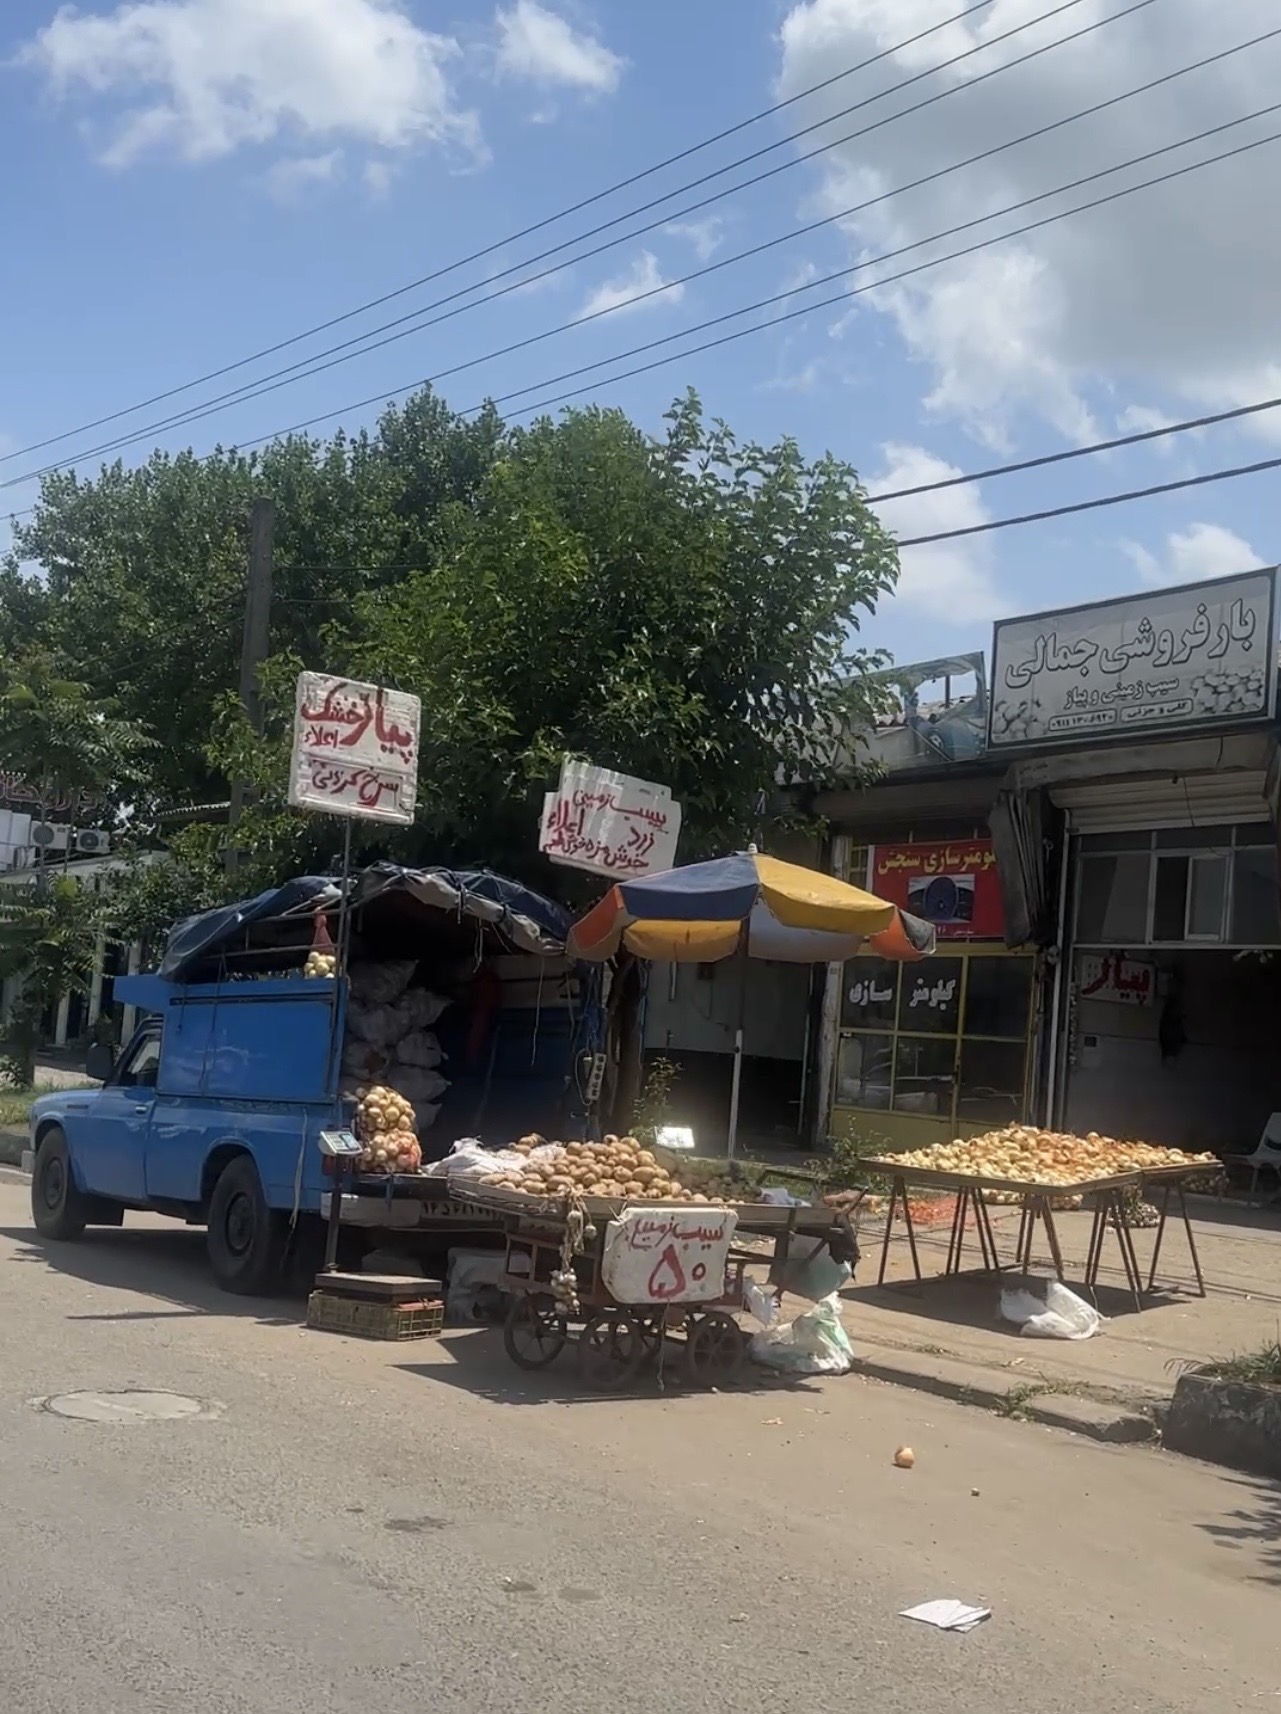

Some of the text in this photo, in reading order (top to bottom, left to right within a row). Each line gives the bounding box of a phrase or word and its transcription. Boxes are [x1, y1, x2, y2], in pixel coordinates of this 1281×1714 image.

[1004, 632, 1099, 689] جمالی
[1063, 677, 1180, 711] سیب زمینی و پیاز
[300, 682, 414, 764] پیاز خشک
[311, 762, 400, 808] سرخ کردنی
[609, 796, 668, 835] سیب
[602, 844, 650, 870] خوش
[627, 826, 655, 856] زرد
[848, 979, 894, 1007] سازی
[1081, 952, 1151, 1007] پیاز
[672, 1221, 725, 1252] سیب
